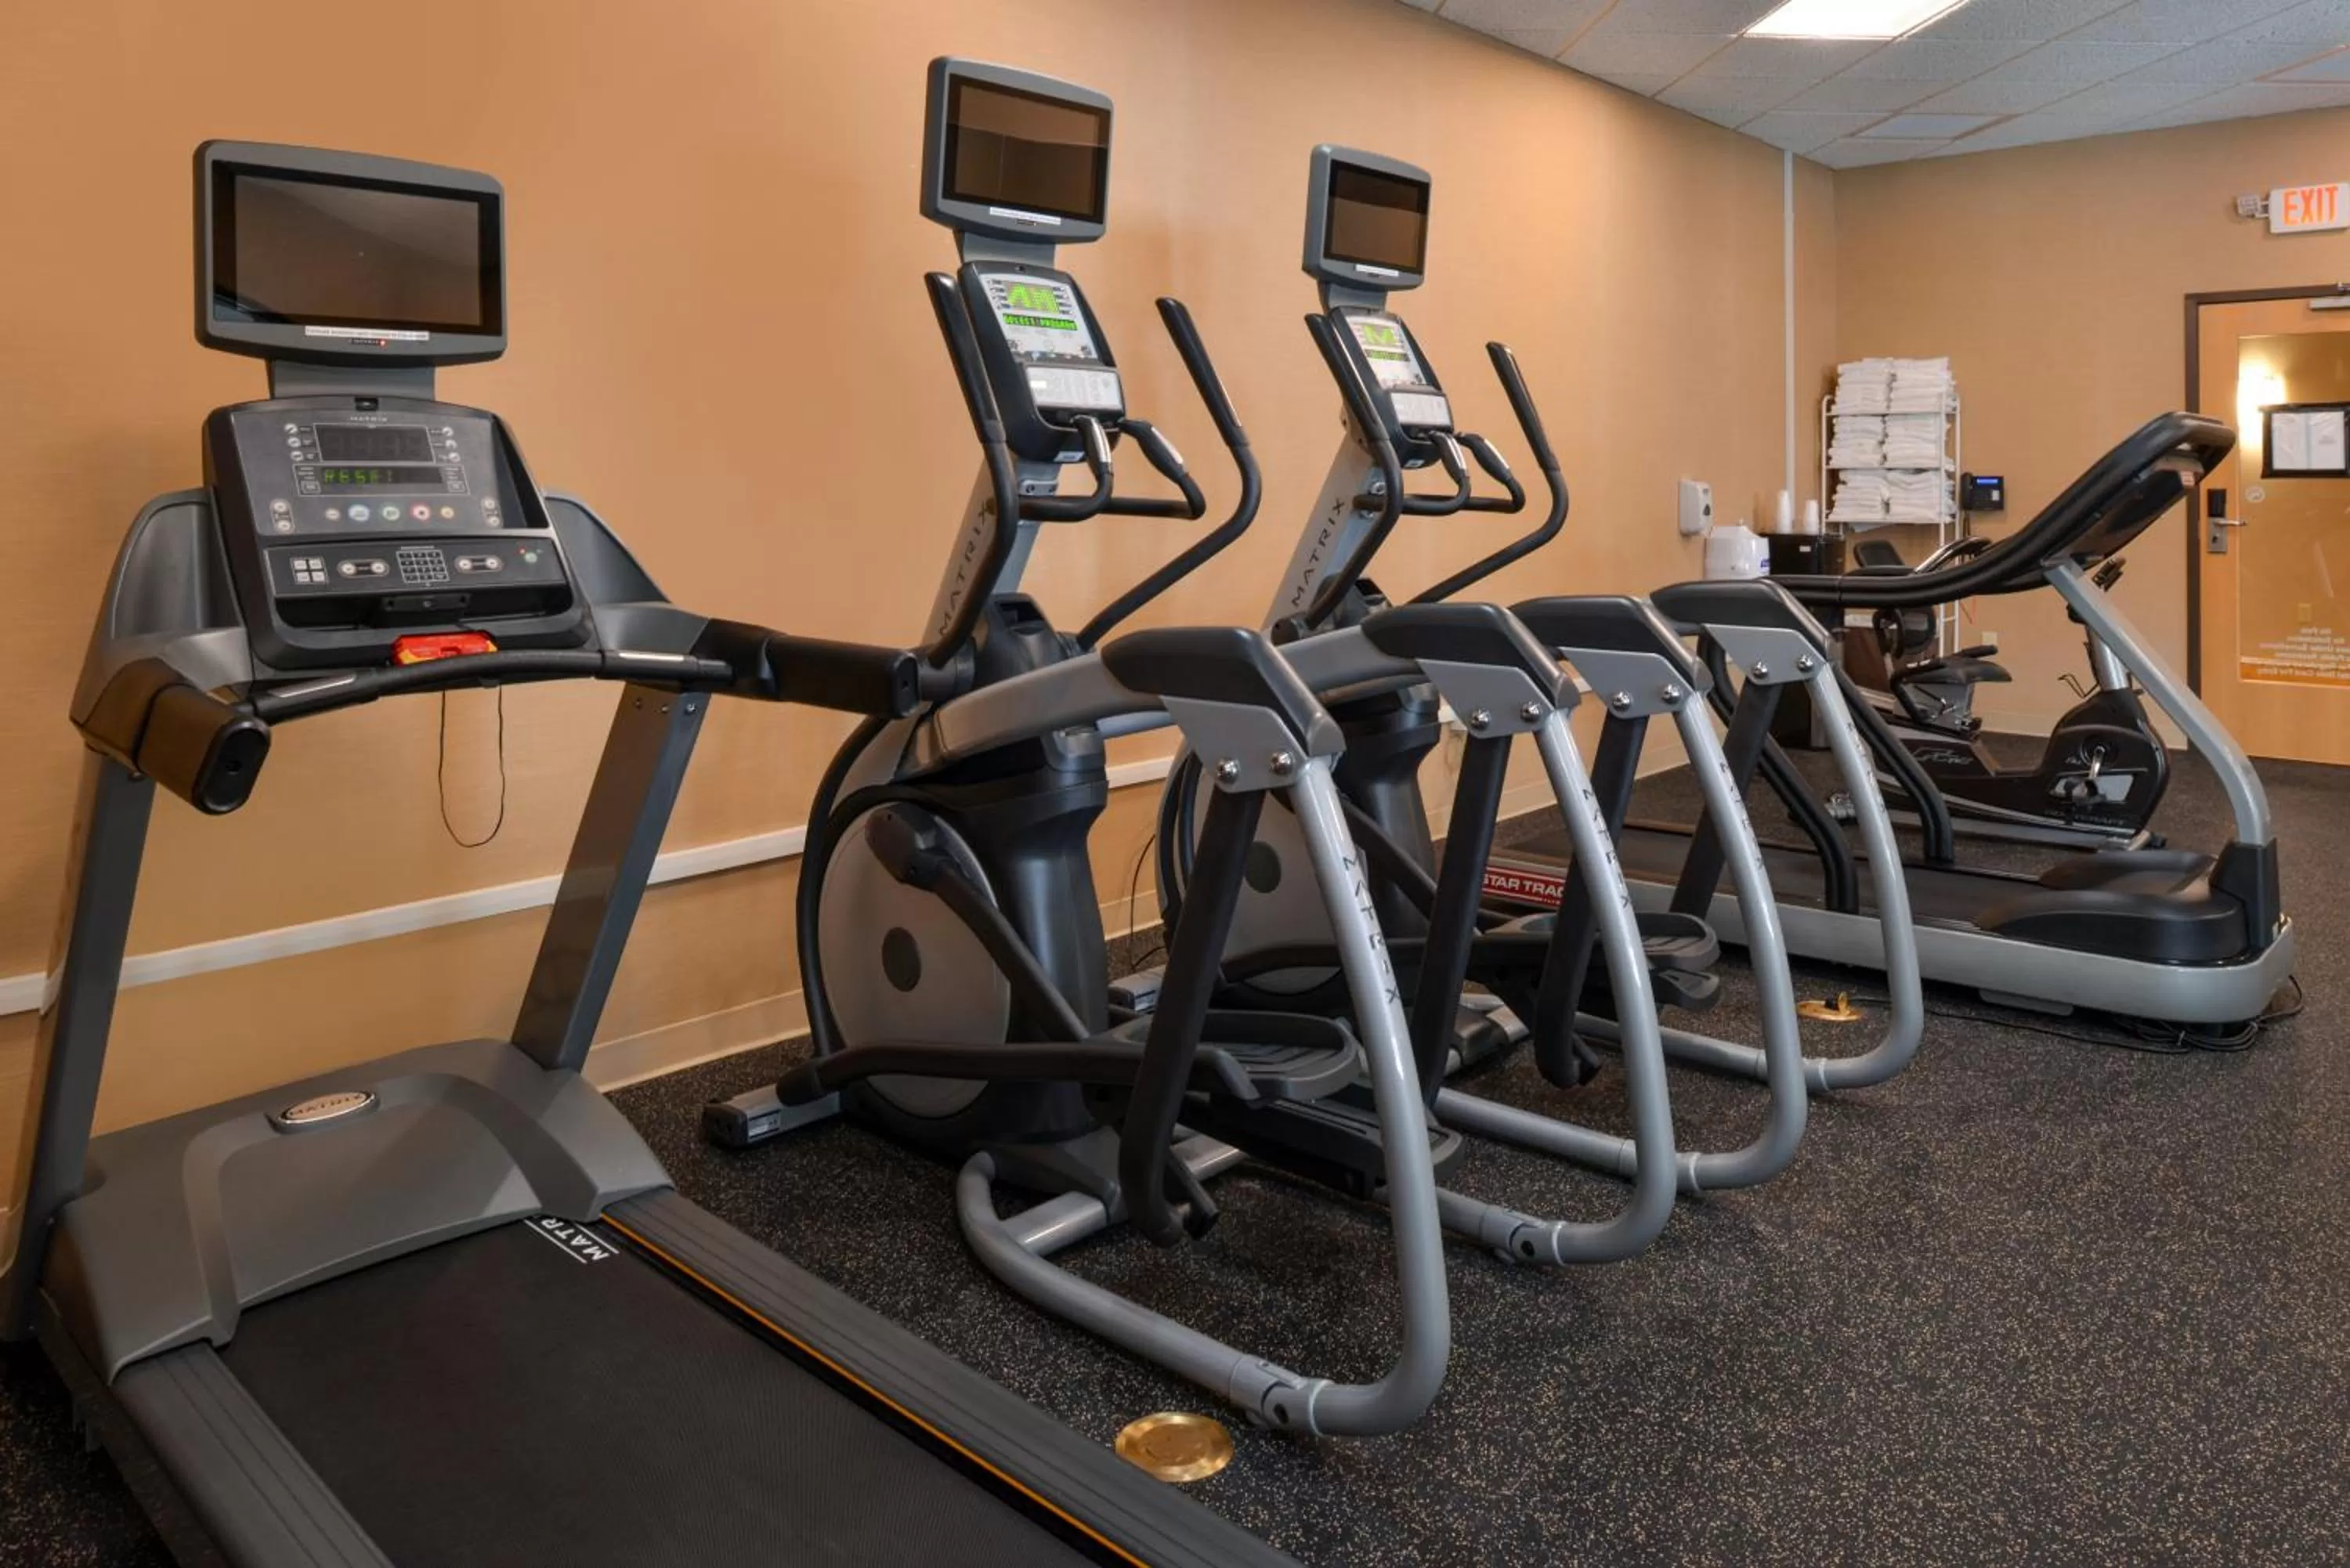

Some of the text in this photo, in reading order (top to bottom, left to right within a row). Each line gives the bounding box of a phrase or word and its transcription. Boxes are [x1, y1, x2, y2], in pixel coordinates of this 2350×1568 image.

[2283, 185, 2339, 227] EXIT
[938, 501, 985, 637] MATRIX
[1291, 497, 1345, 608] MATRIX
[1343, 856, 1401, 1004] MATRIX
[541, 1218, 610, 1260] MATR
